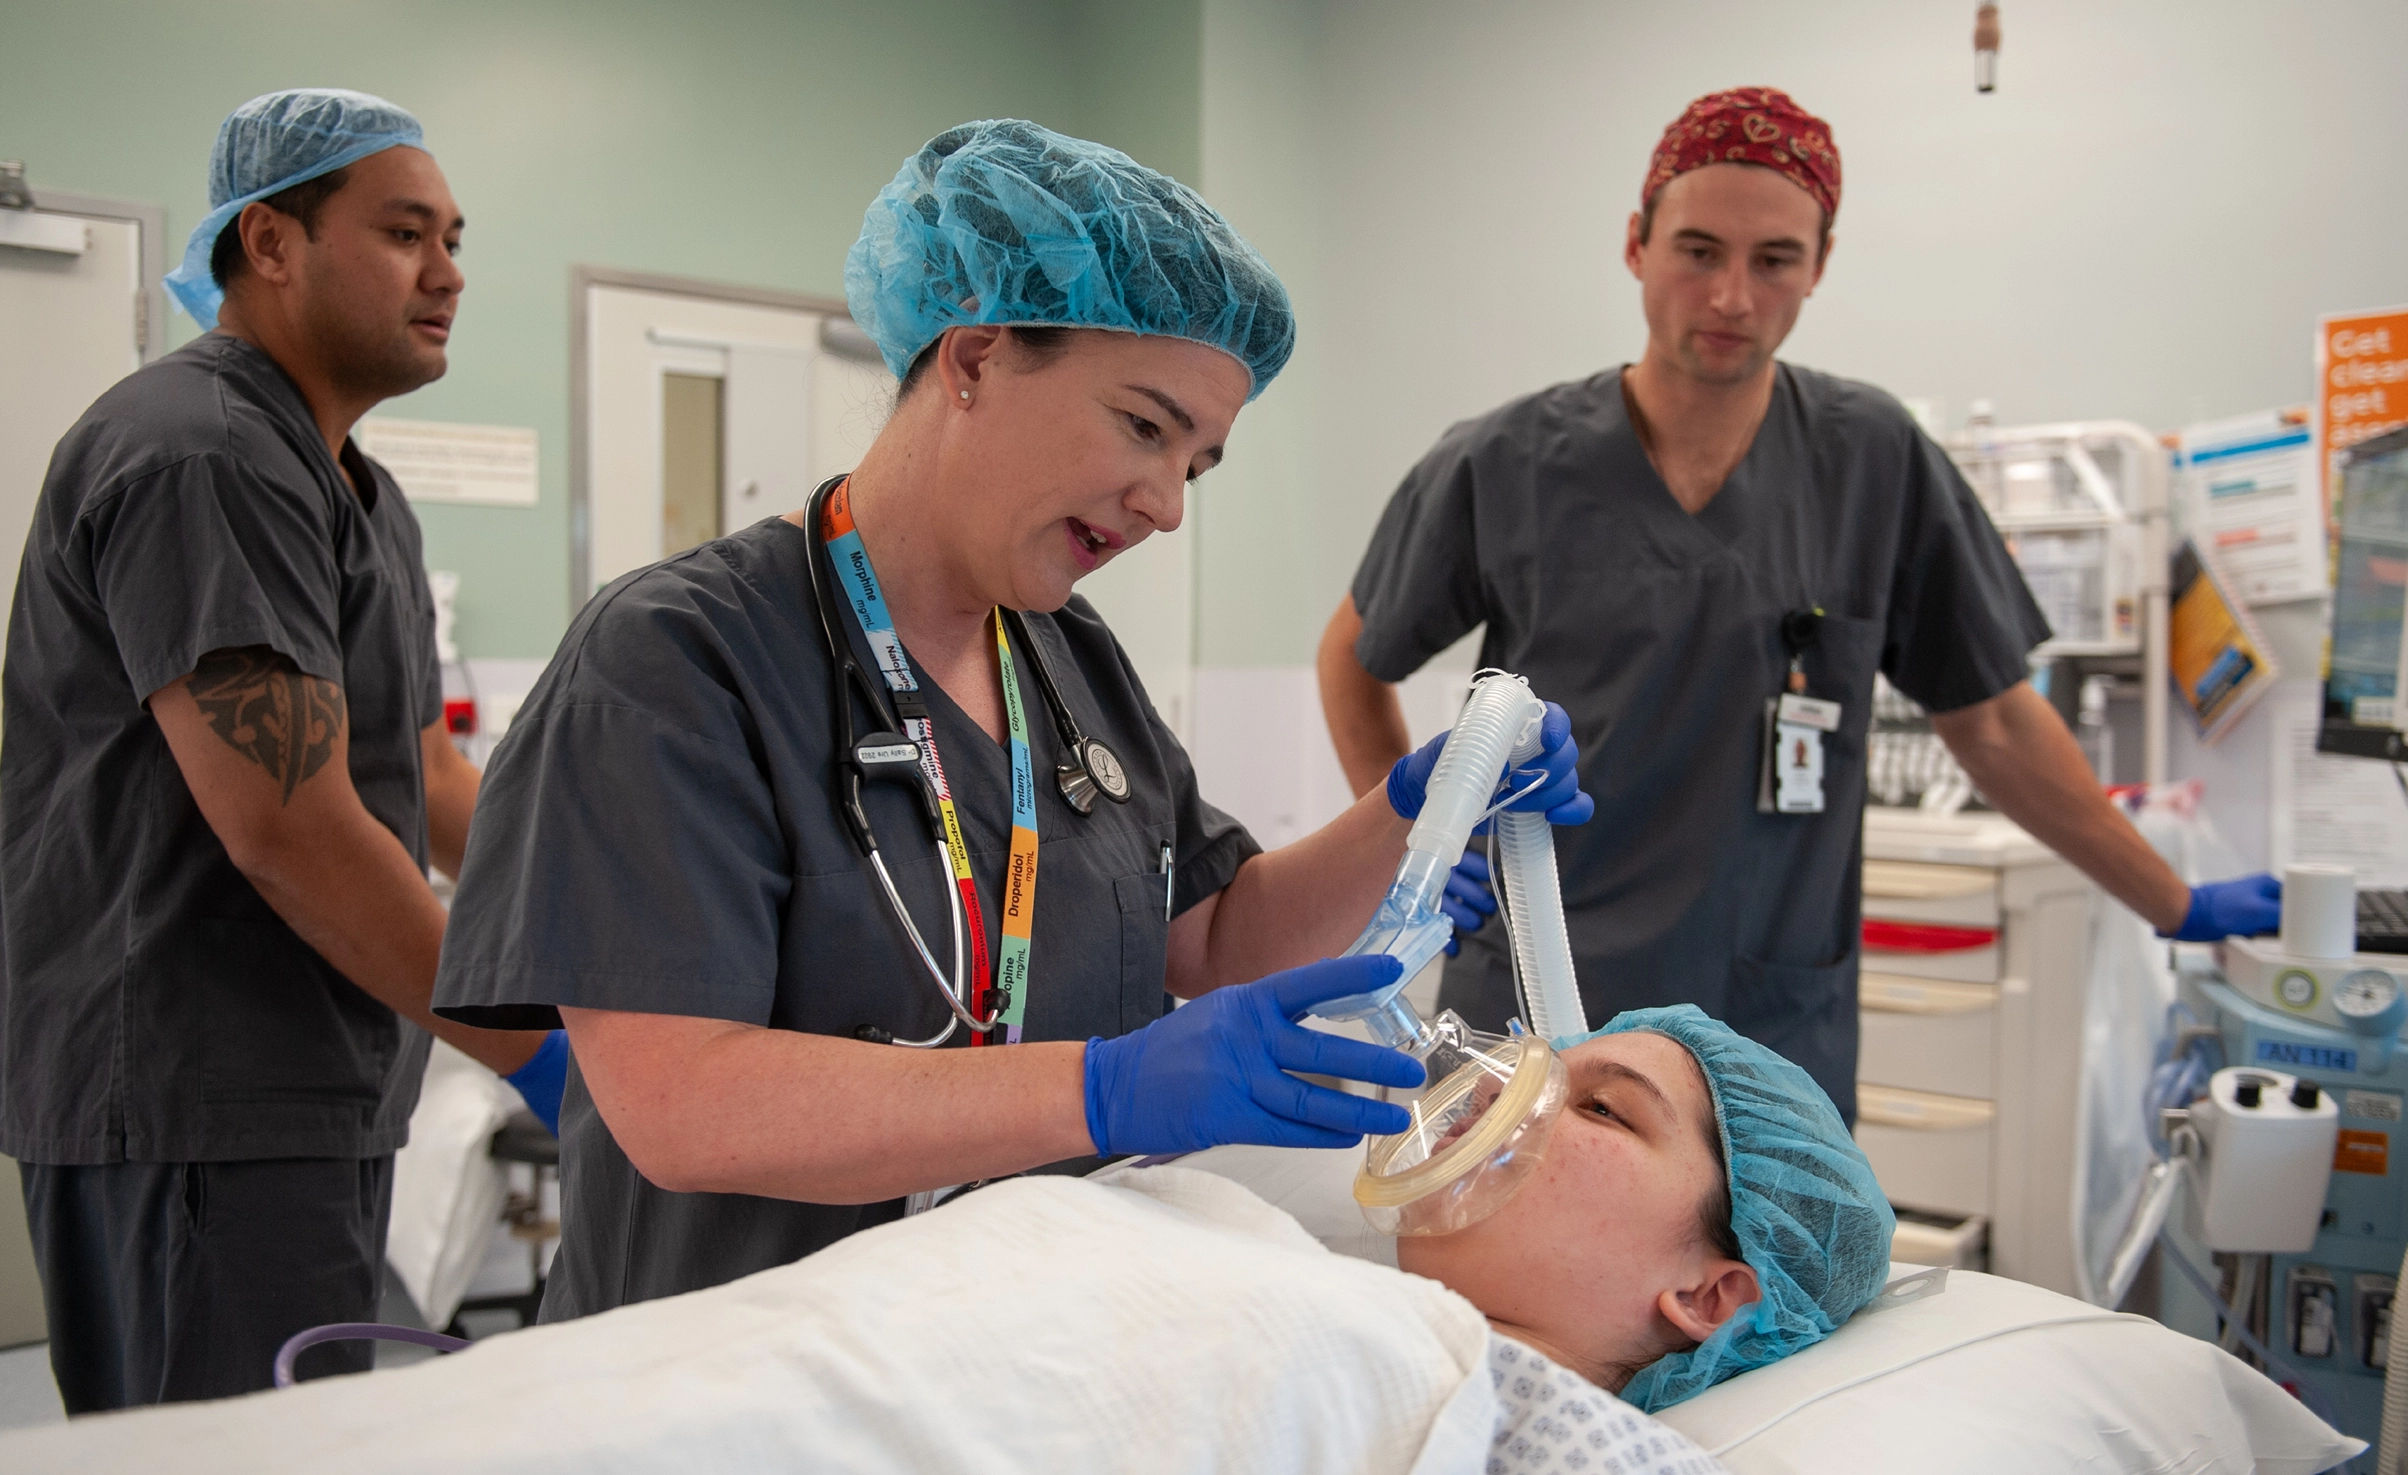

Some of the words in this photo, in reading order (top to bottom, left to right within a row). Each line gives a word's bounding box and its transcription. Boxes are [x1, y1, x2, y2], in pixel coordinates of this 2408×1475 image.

[2331, 328, 2390, 358] Get
[850, 550, 877, 601] Morphine
[856, 599, 875, 629] mg/mL
[886, 645, 911, 691] Naloxone
[891, 748, 906, 758] Sally
[1016, 767, 1026, 815] Fentanyl
[946, 810, 966, 861] Propofol
[949, 841, 963, 874] mg/mL
[1025, 850, 1035, 882] mg/mL
[1008, 854, 1024, 918] Droperidol
[969, 891, 987, 967] Rocuronium
[1016, 948, 1026, 980] mg/mL
